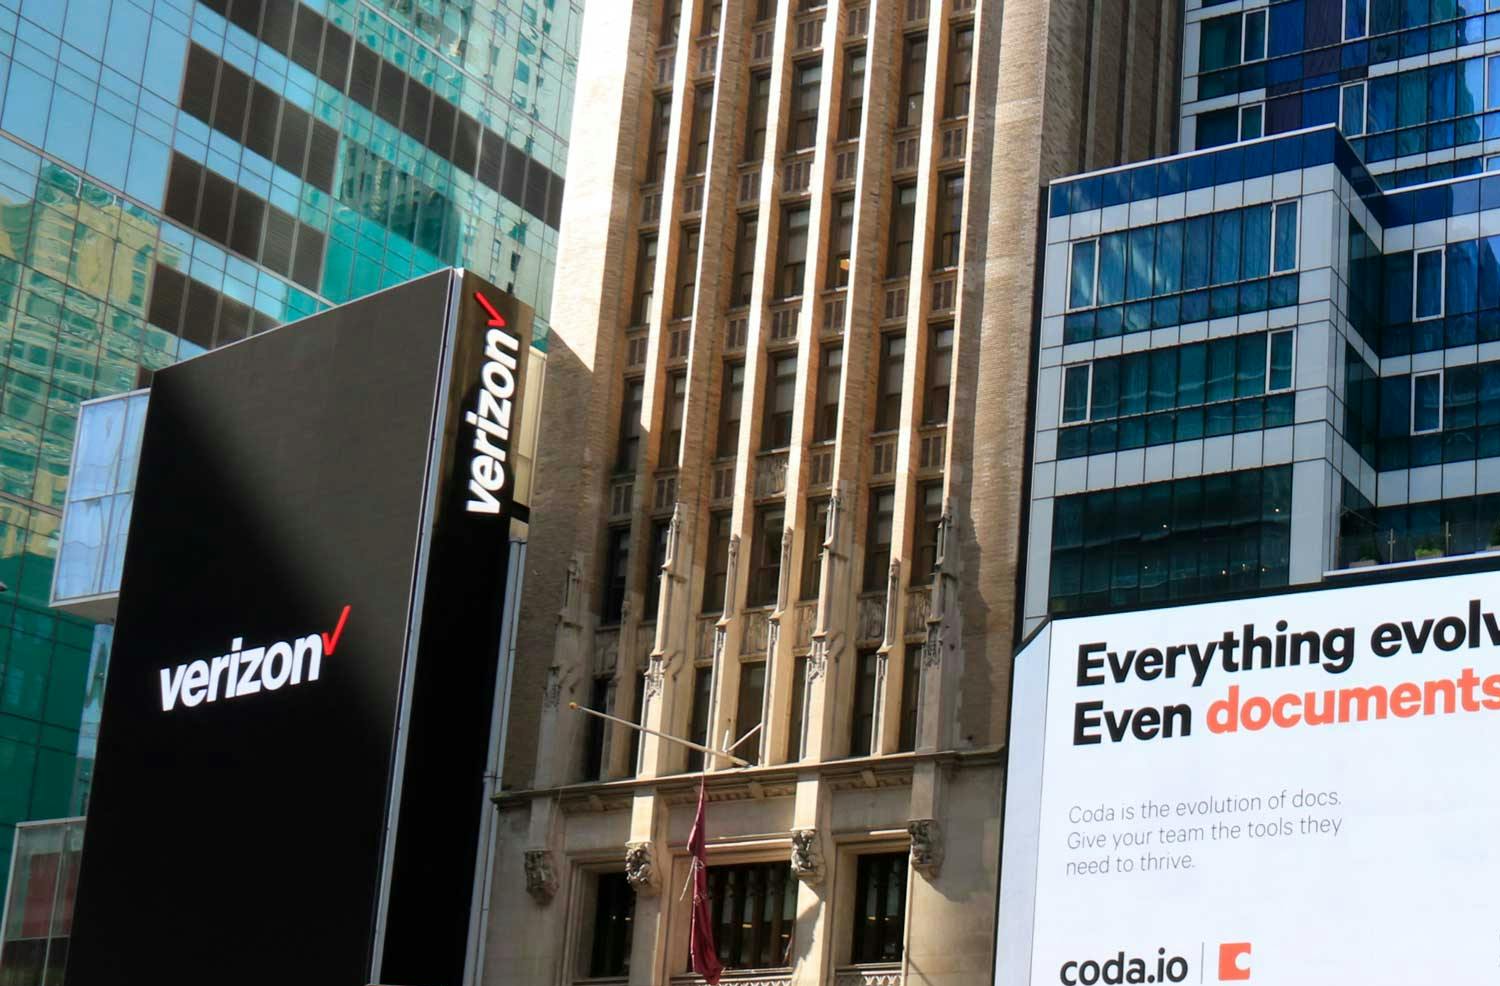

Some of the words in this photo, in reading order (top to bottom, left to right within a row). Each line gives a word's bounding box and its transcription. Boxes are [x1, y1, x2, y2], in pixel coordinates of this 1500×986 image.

[466, 326, 519, 514] verizon
[159, 631, 322, 712] verizon
[1077, 619, 1354, 687] Everything
[1072, 698, 1192, 746] Even
[1068, 804, 1115, 825] Coda
[1120, 803, 1134, 821] is
[1140, 800, 1170, 820] the
[1175, 793, 1262, 817] evolution
[1267, 790, 1287, 809] of
[1291, 786, 1342, 808] docs.
[1066, 829, 1107, 850] Give
[1112, 829, 1152, 852] your
[1158, 825, 1205, 844] team
[1211, 820, 1241, 841] the
[1247, 817, 1293, 839] tools
[1300, 814, 1342, 840] they
[1065, 854, 1110, 876] need
[1116, 855, 1135, 872] to
[1139, 850, 1196, 870] thrive.
[1059, 946, 1189, 986] coda.io
